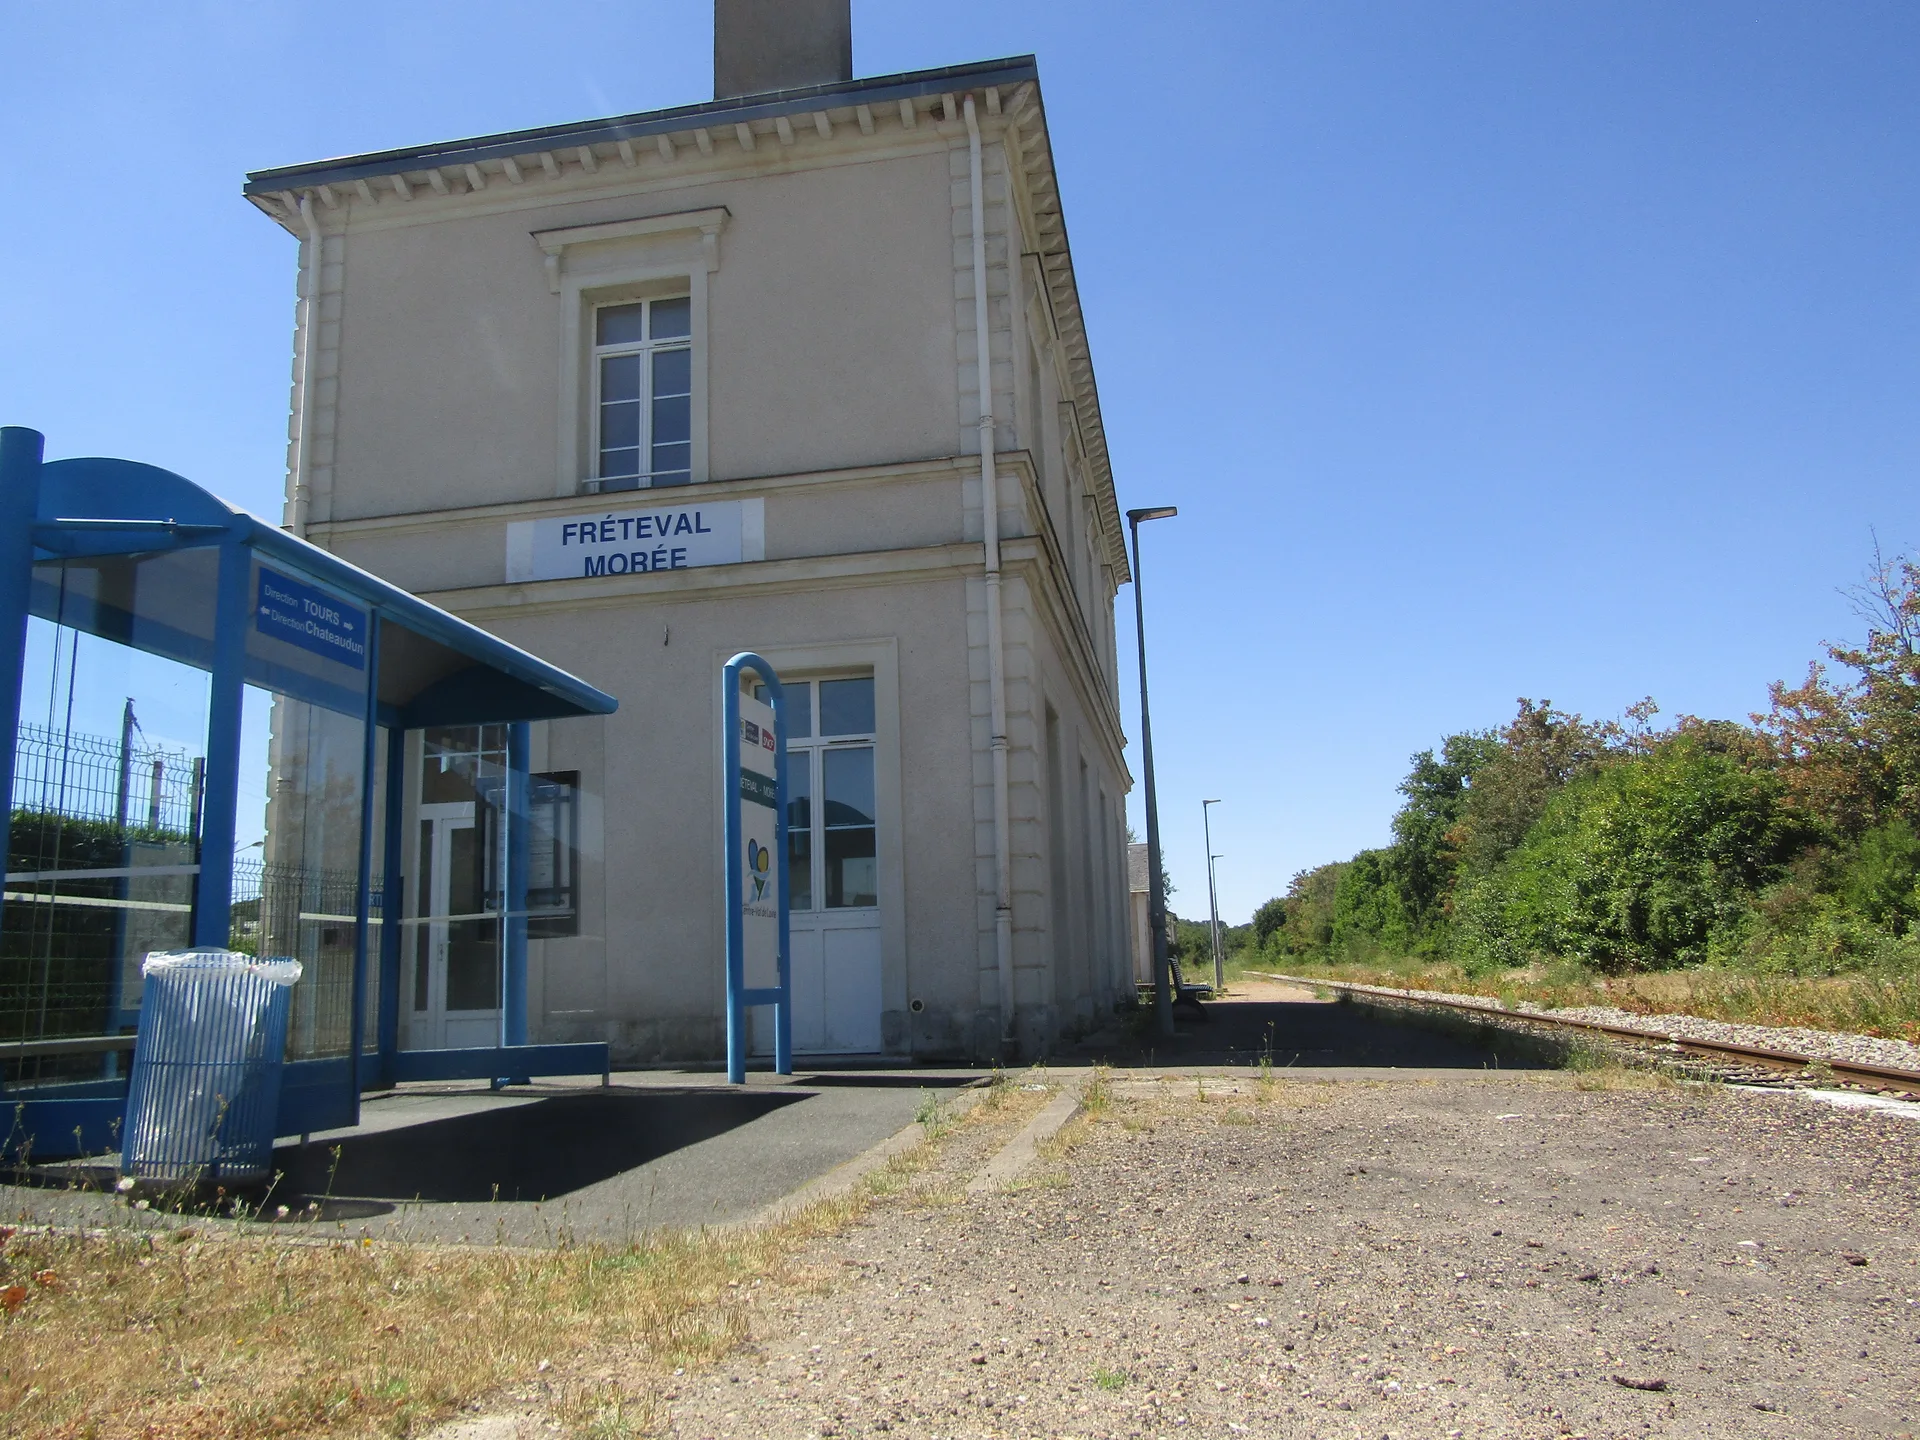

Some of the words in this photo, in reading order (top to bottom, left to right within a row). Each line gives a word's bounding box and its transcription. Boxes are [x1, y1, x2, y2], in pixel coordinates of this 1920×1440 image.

[562, 511, 712, 545] FRÉTEVAL
[584, 544, 687, 577] MORÉE
[264, 584, 299, 608] Direction
[303, 598, 340, 626] TOURS
[271, 609, 305, 632] Direction
[305, 620, 364, 655] Chateaudun
[762, 736, 774, 749] SNCF
[740, 774, 758, 793] ÉTEVAL
